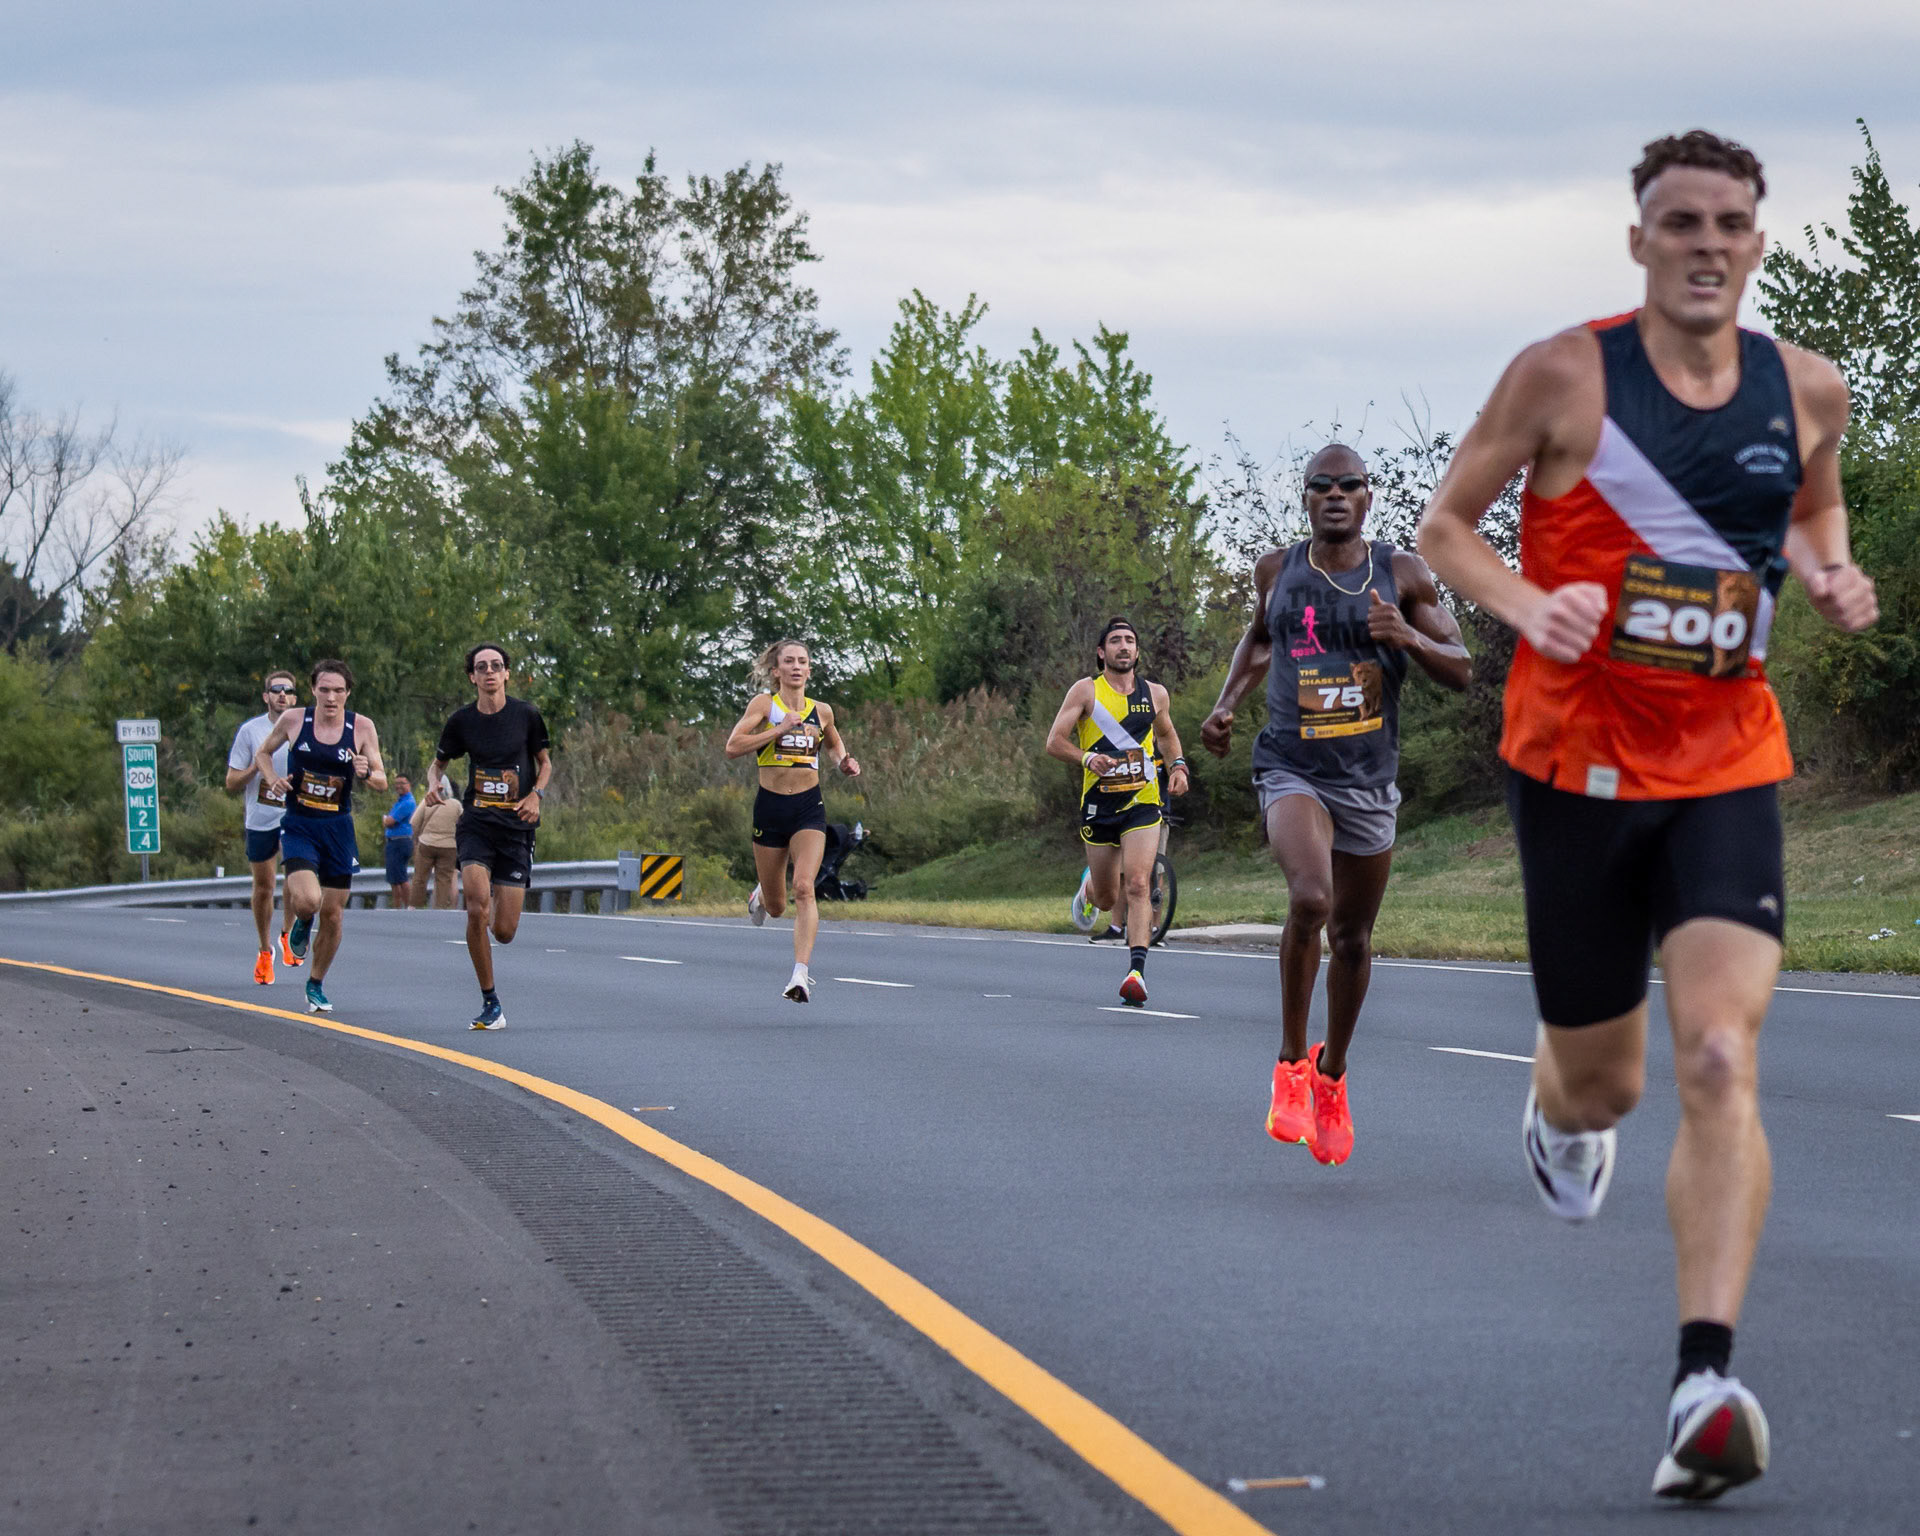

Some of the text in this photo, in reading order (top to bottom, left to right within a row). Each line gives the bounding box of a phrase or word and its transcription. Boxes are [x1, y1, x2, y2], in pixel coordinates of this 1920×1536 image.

[1624, 599, 1747, 650] 200
[1299, 669, 1319, 677] THE
[1299, 677, 1334, 686] CHASE
[1318, 686, 1365, 710] 75
[1130, 704, 1151, 713] GSTC
[122, 726, 157, 737] BY-PASS
[781, 734, 814, 749] 251
[127, 748, 154, 762] SOUTH
[130, 772, 153, 785] 206
[307, 782, 337, 798] 137
[483, 781, 510, 794] 29
[129, 795, 155, 808] MILE
[138, 810, 148, 827] 2
